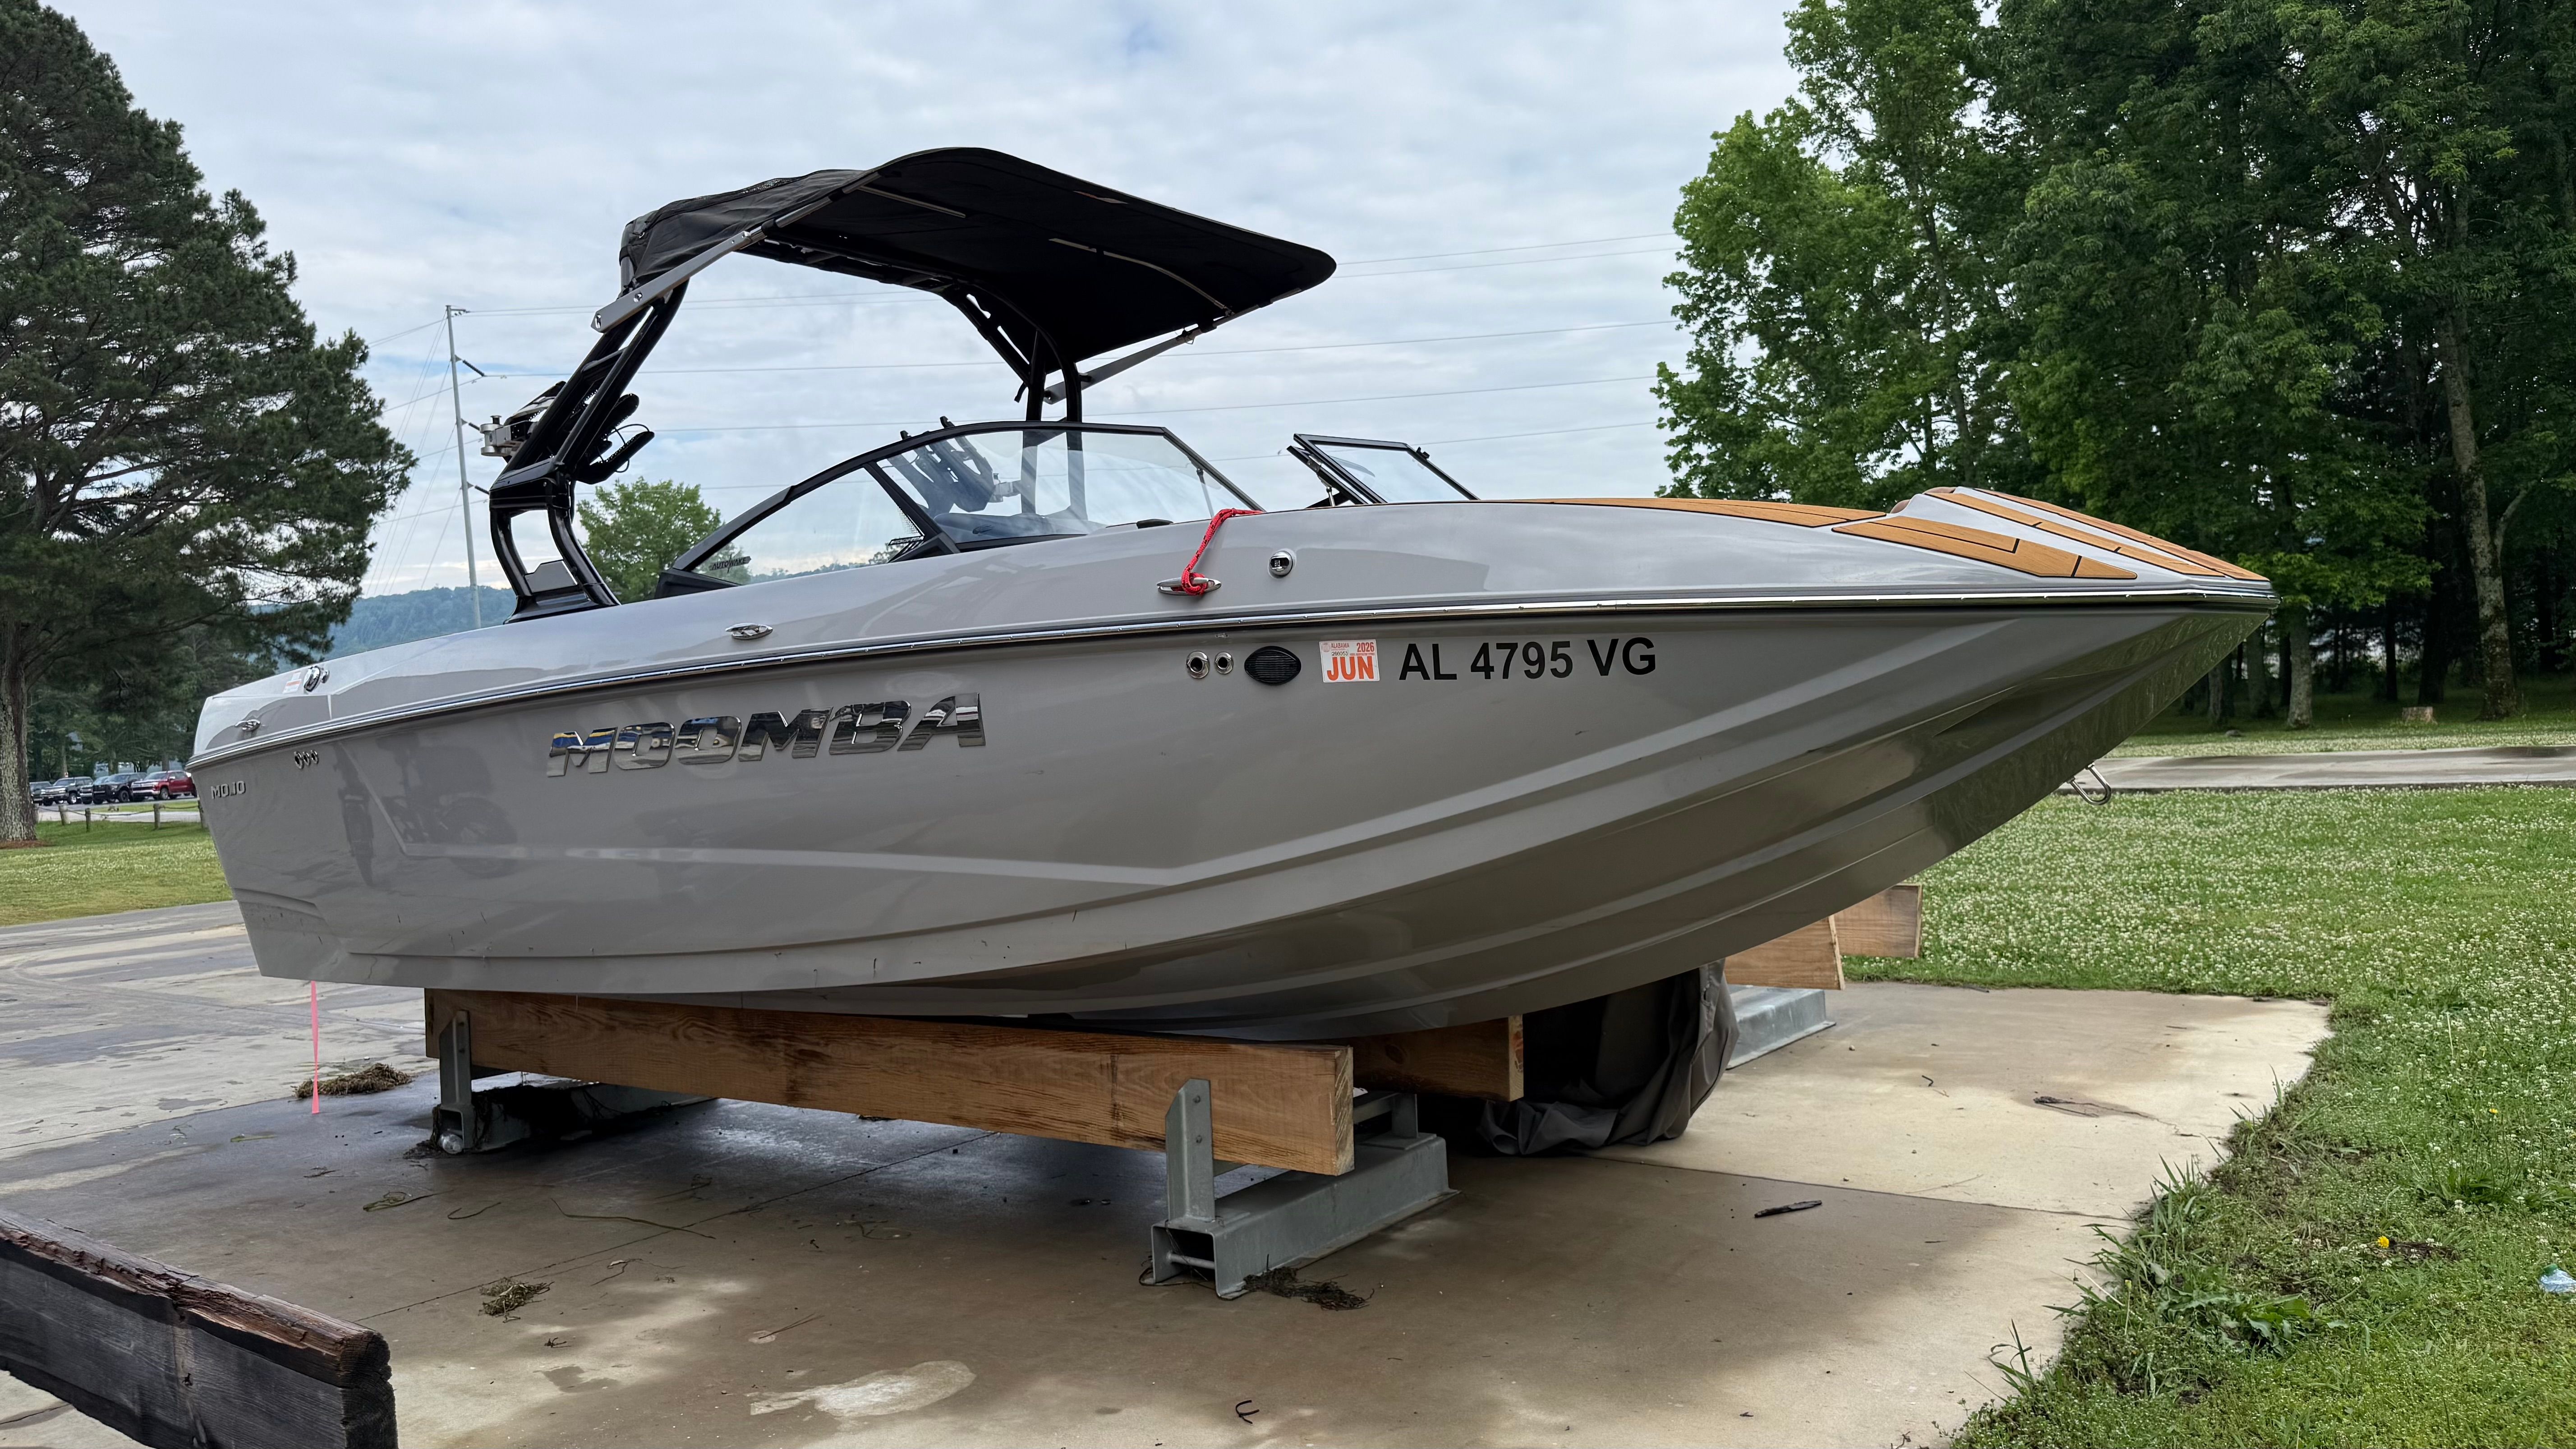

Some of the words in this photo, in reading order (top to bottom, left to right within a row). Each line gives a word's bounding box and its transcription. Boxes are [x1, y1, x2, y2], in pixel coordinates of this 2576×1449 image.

[1357, 642, 1375, 652] 2026
[1399, 644, 1457, 680] AL
[1470, 641, 1573, 679] 4795
[1587, 637, 1656, 676] VG
[1327, 656, 1374, 681] JUN
[547, 693, 986, 777] MOOMBA
[211, 781, 246, 799] MOJO
